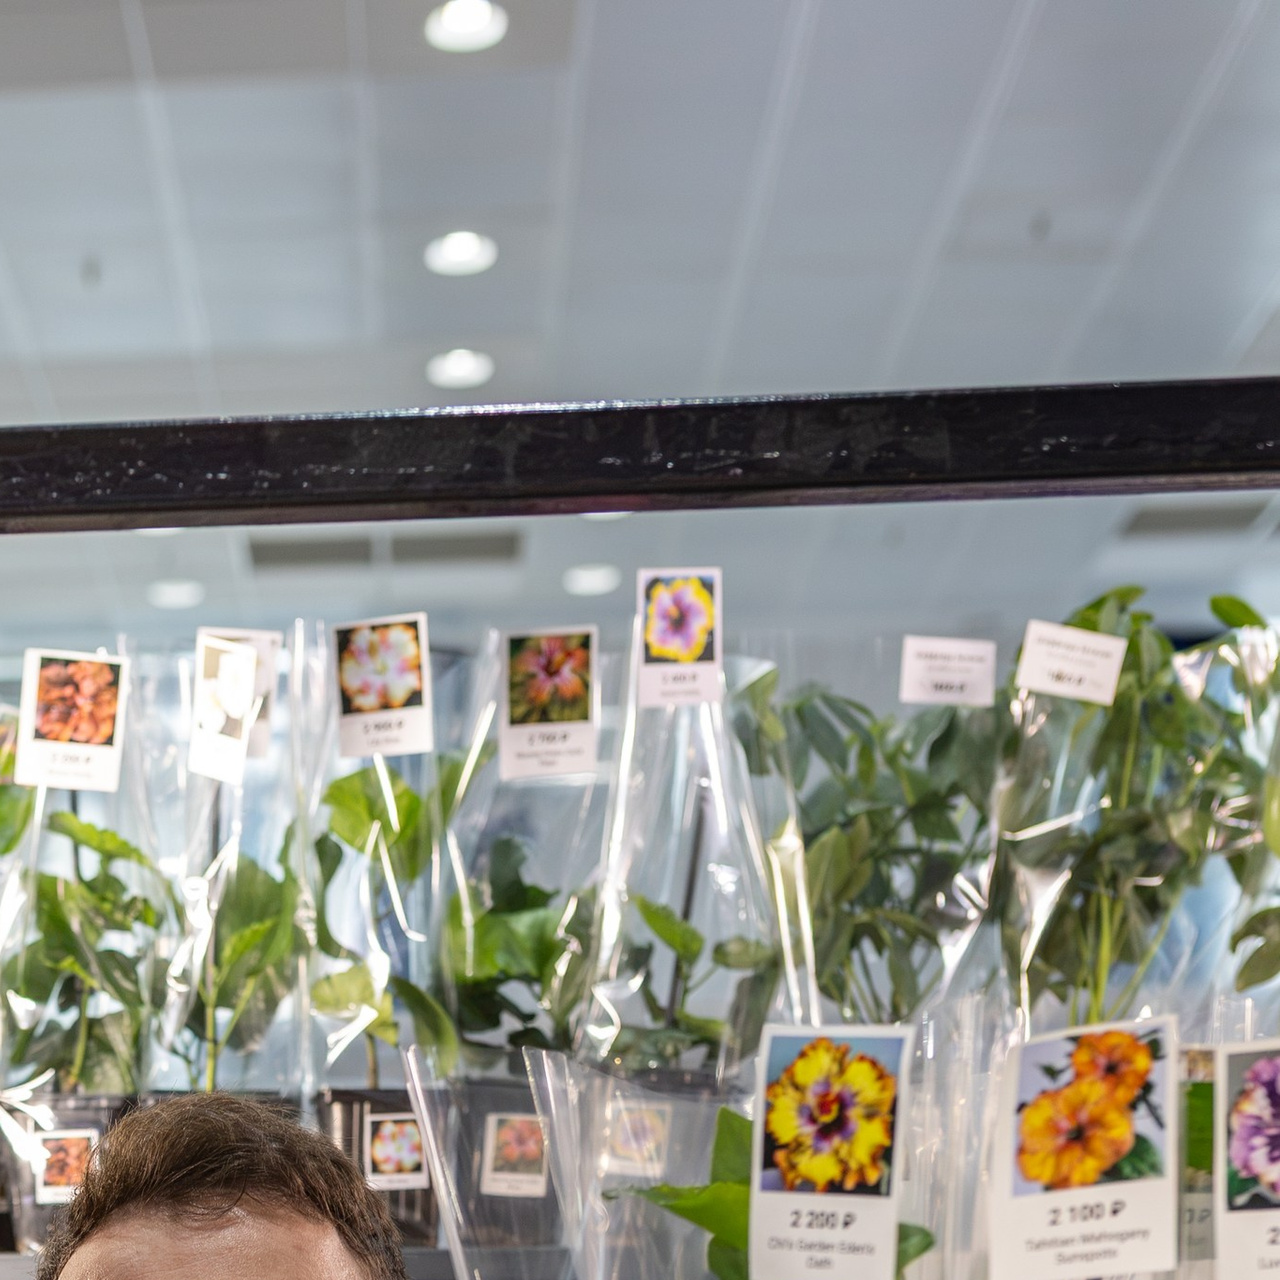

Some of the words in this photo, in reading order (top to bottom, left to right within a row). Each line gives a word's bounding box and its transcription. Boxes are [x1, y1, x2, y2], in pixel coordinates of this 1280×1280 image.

[790, 1210, 802, 1228] 2
[806, 1211, 838, 1229] 200
[1049, 1208, 1060, 1226] 2
[1068, 1203, 1105, 1222] 100
